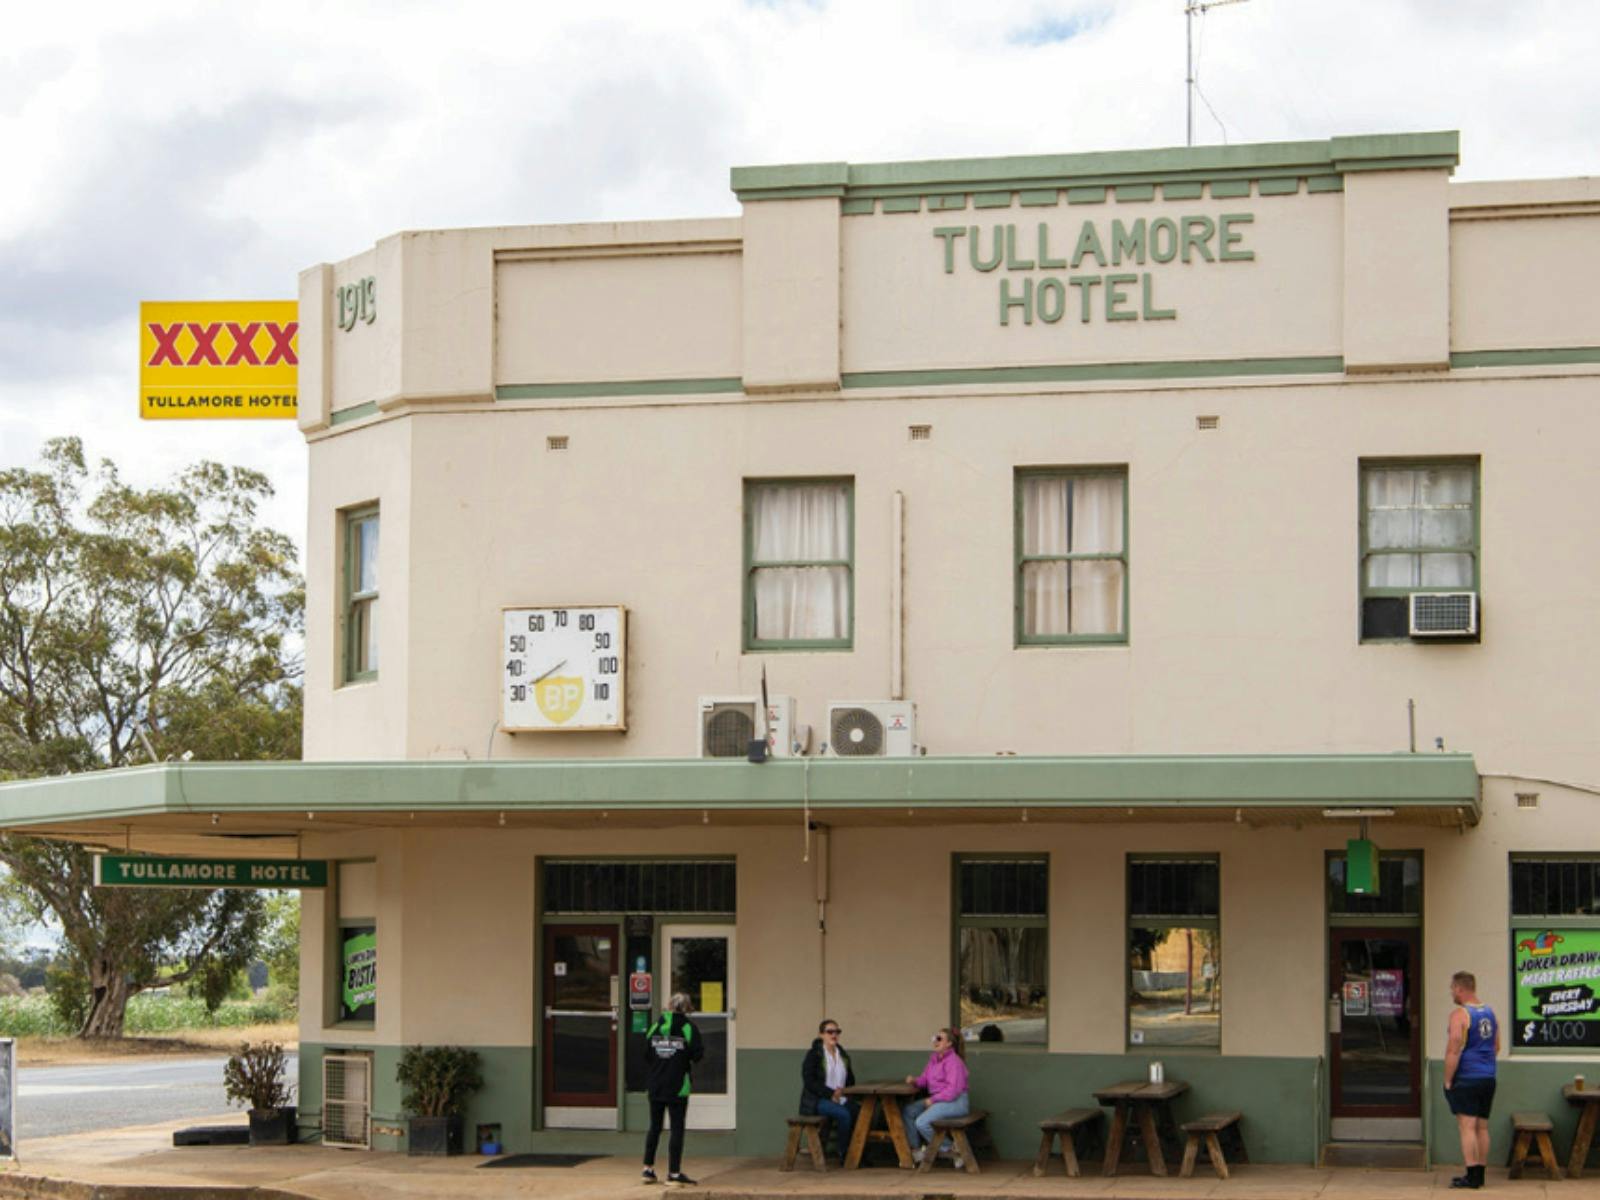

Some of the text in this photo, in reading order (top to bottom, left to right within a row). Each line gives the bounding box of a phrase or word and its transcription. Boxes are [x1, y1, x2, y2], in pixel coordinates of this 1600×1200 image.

[933, 213, 1254, 274] TULLAMORE
[337, 276, 376, 332] 1919
[999, 273, 1177, 326] HOTEL
[148, 323, 298, 365] XXXX
[148, 396, 298, 407] TULLAMORE HOTEL
[528, 615, 544, 632] 60
[553, 610, 567, 627] 70
[579, 614, 594, 631] 80
[510, 635, 526, 652] 50
[595, 632, 610, 649] 90
[506, 659, 522, 677] 40
[599, 656, 617, 675] 100
[510, 685, 526, 702] 30
[545, 685, 579, 712] BP
[594, 683, 609, 701] 110
[119, 862, 311, 881] TULLAMORE HOTEL
[1518, 951, 1598, 972] JOKER DRAW
